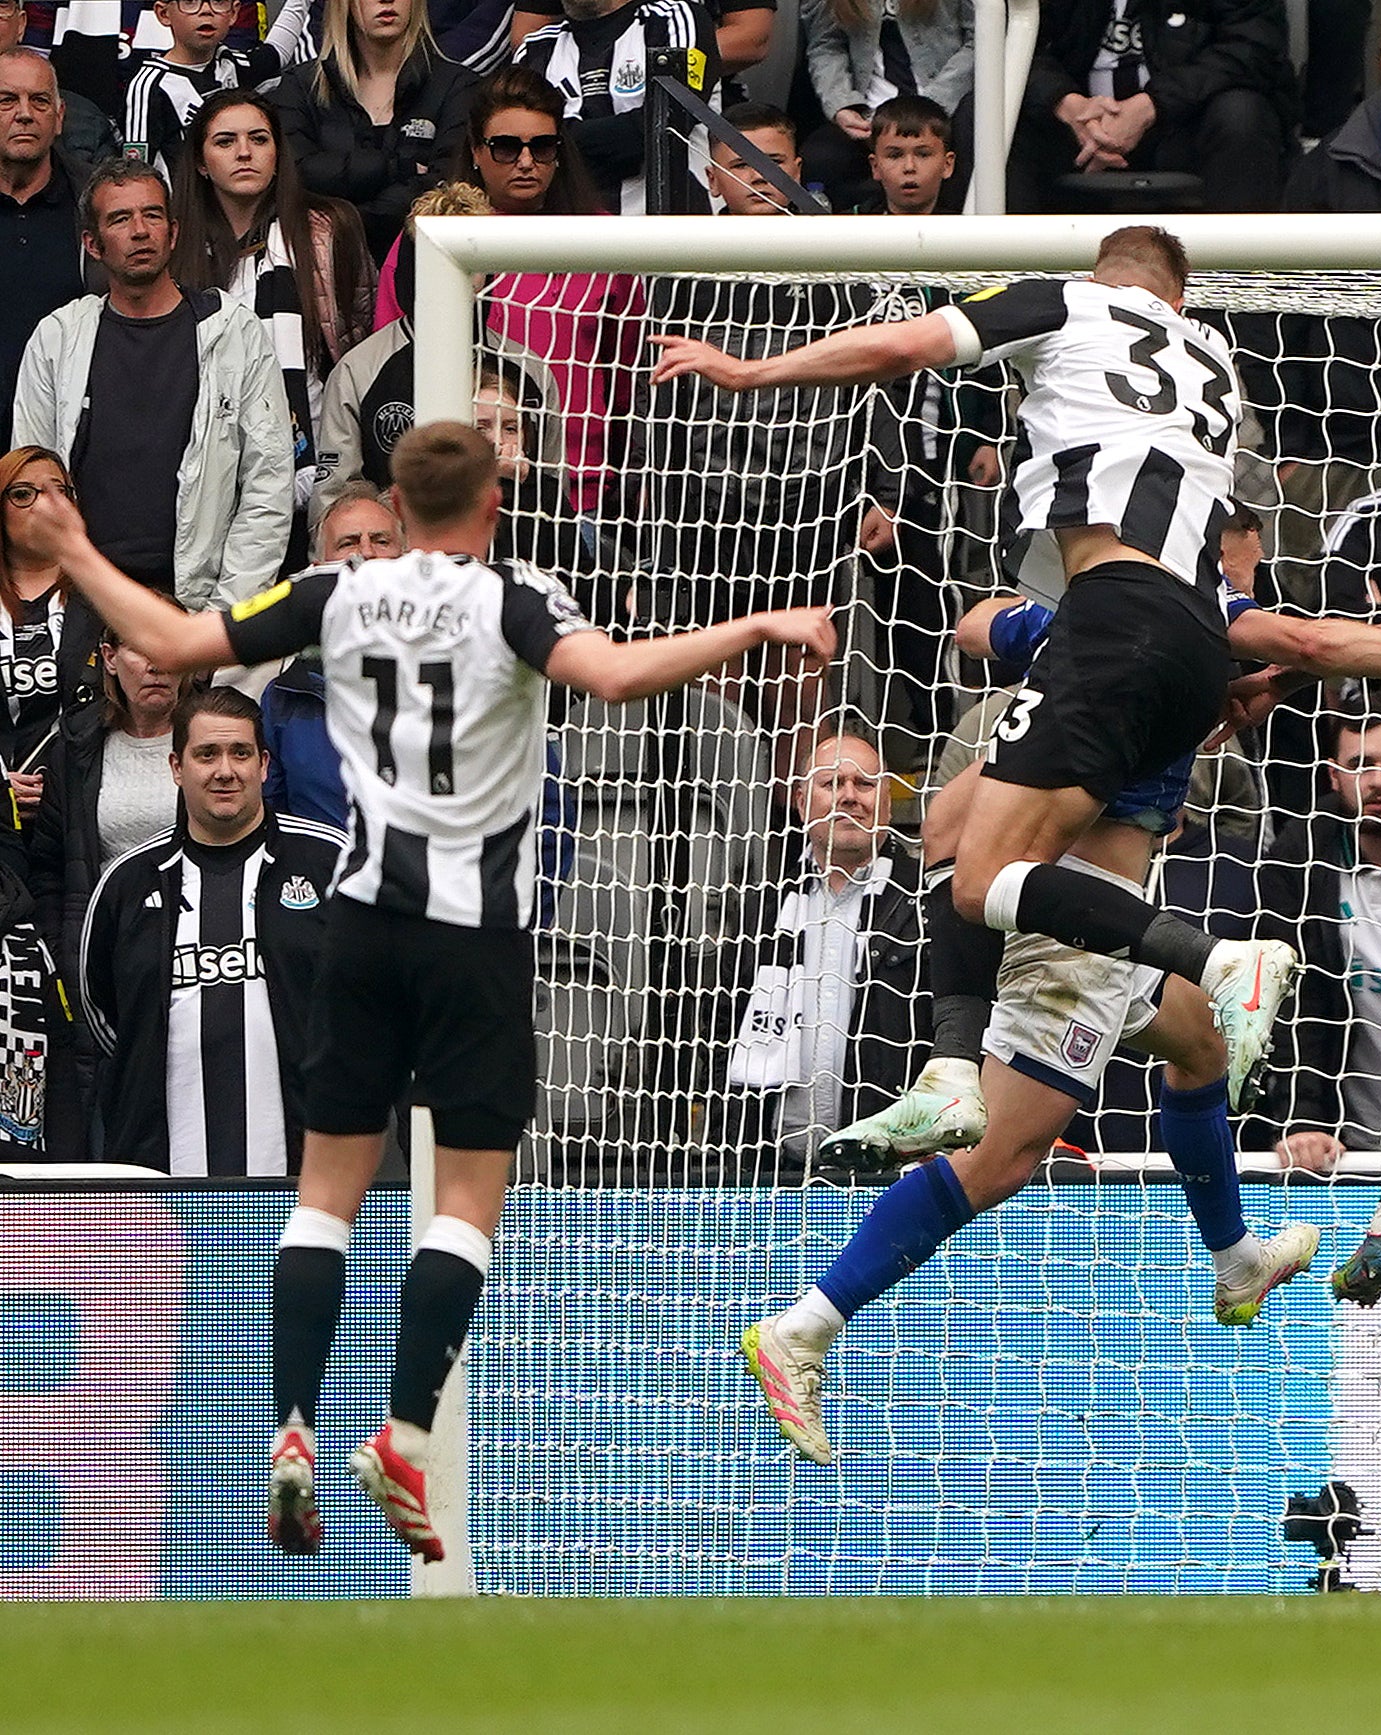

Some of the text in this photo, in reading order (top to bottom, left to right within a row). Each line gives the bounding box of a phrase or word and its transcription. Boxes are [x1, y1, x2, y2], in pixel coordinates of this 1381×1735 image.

[1103, 303, 1234, 459] 33
[361, 654, 456, 796] 11
[990, 687, 1046, 743] 3
